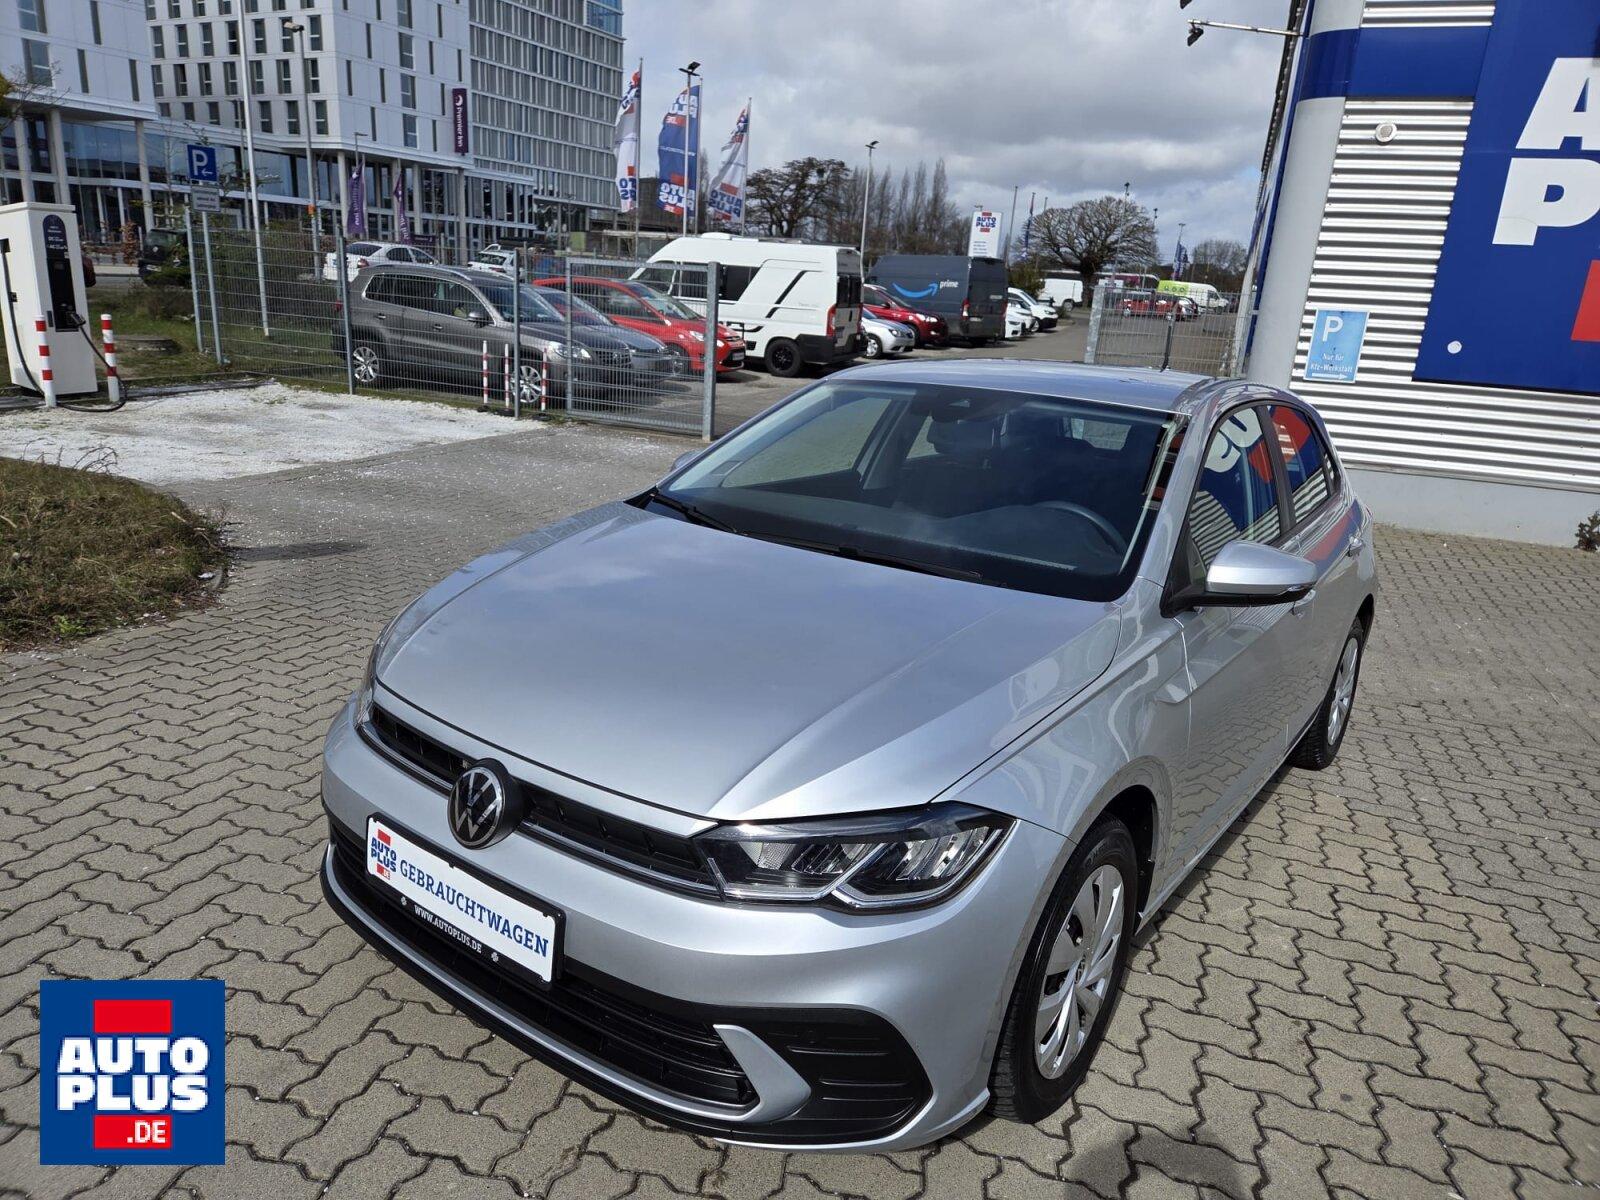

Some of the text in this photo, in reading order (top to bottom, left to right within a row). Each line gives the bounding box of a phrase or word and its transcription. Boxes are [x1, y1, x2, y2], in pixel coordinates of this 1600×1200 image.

[456, 107, 464, 135] Premier
[191, 149, 208, 176] P
[939, 280, 959, 288] prime
[1322, 316, 1344, 342] P
[1310, 363, 1353, 373] Kfz-Werkstatt
[1322, 353, 1333, 361] Nur
[371, 837, 397, 861] AUTO
[371, 849, 397, 873] PLUS
[400, 859, 549, 957] GEBRAUCHTWAGEN
[414, 905, 482, 954] WWW.AUTOPLUS.DE
